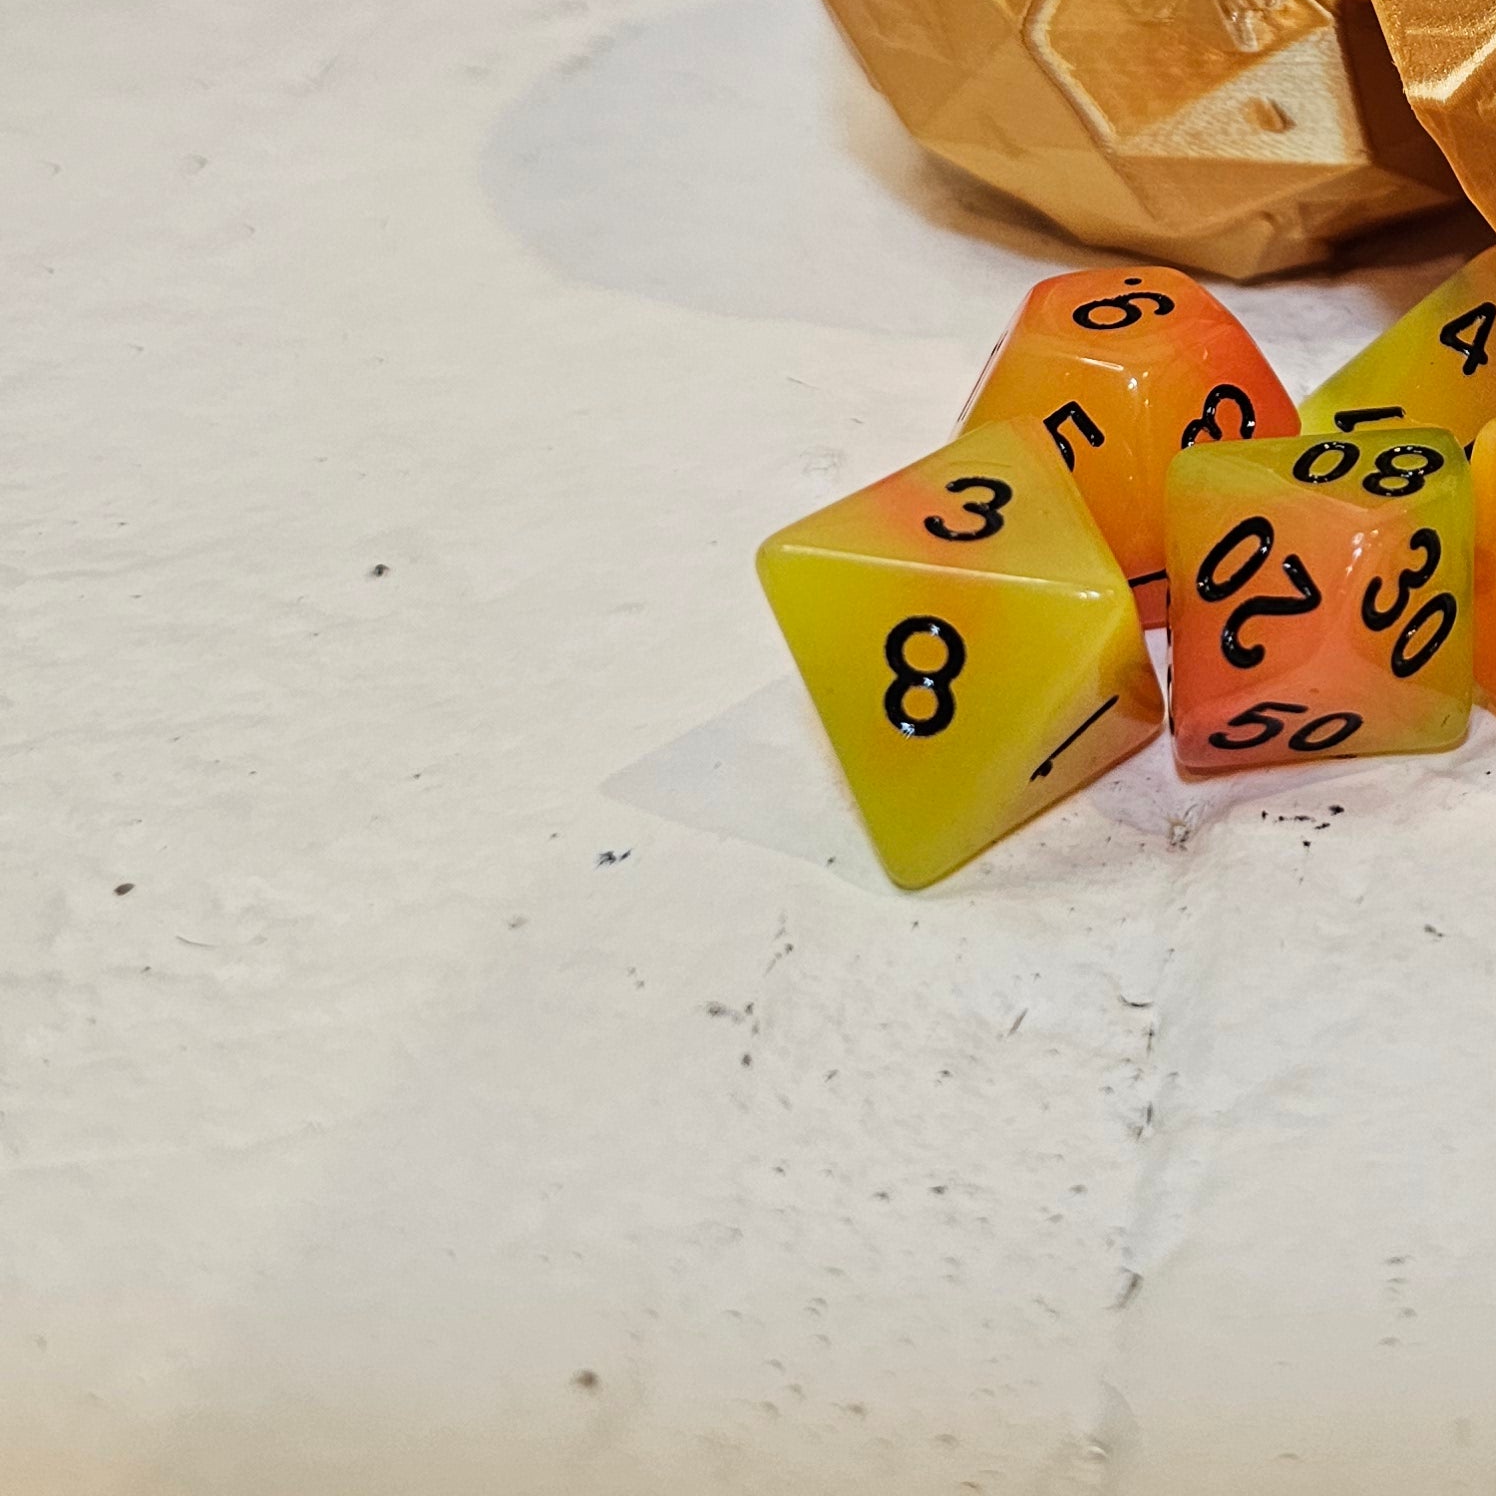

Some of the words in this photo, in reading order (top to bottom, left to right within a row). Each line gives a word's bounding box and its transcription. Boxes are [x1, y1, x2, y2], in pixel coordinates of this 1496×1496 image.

[1334, 404, 1405, 432] 1
[1292, 440, 1445, 498] 80
[924, 476, 1013, 542] 3
[1196, 515, 1323, 670] 20
[1361, 527, 1457, 679] 30
[882, 615, 967, 739] 8
[1029, 694, 1120, 783] 1
[1208, 701, 1364, 752] 50
